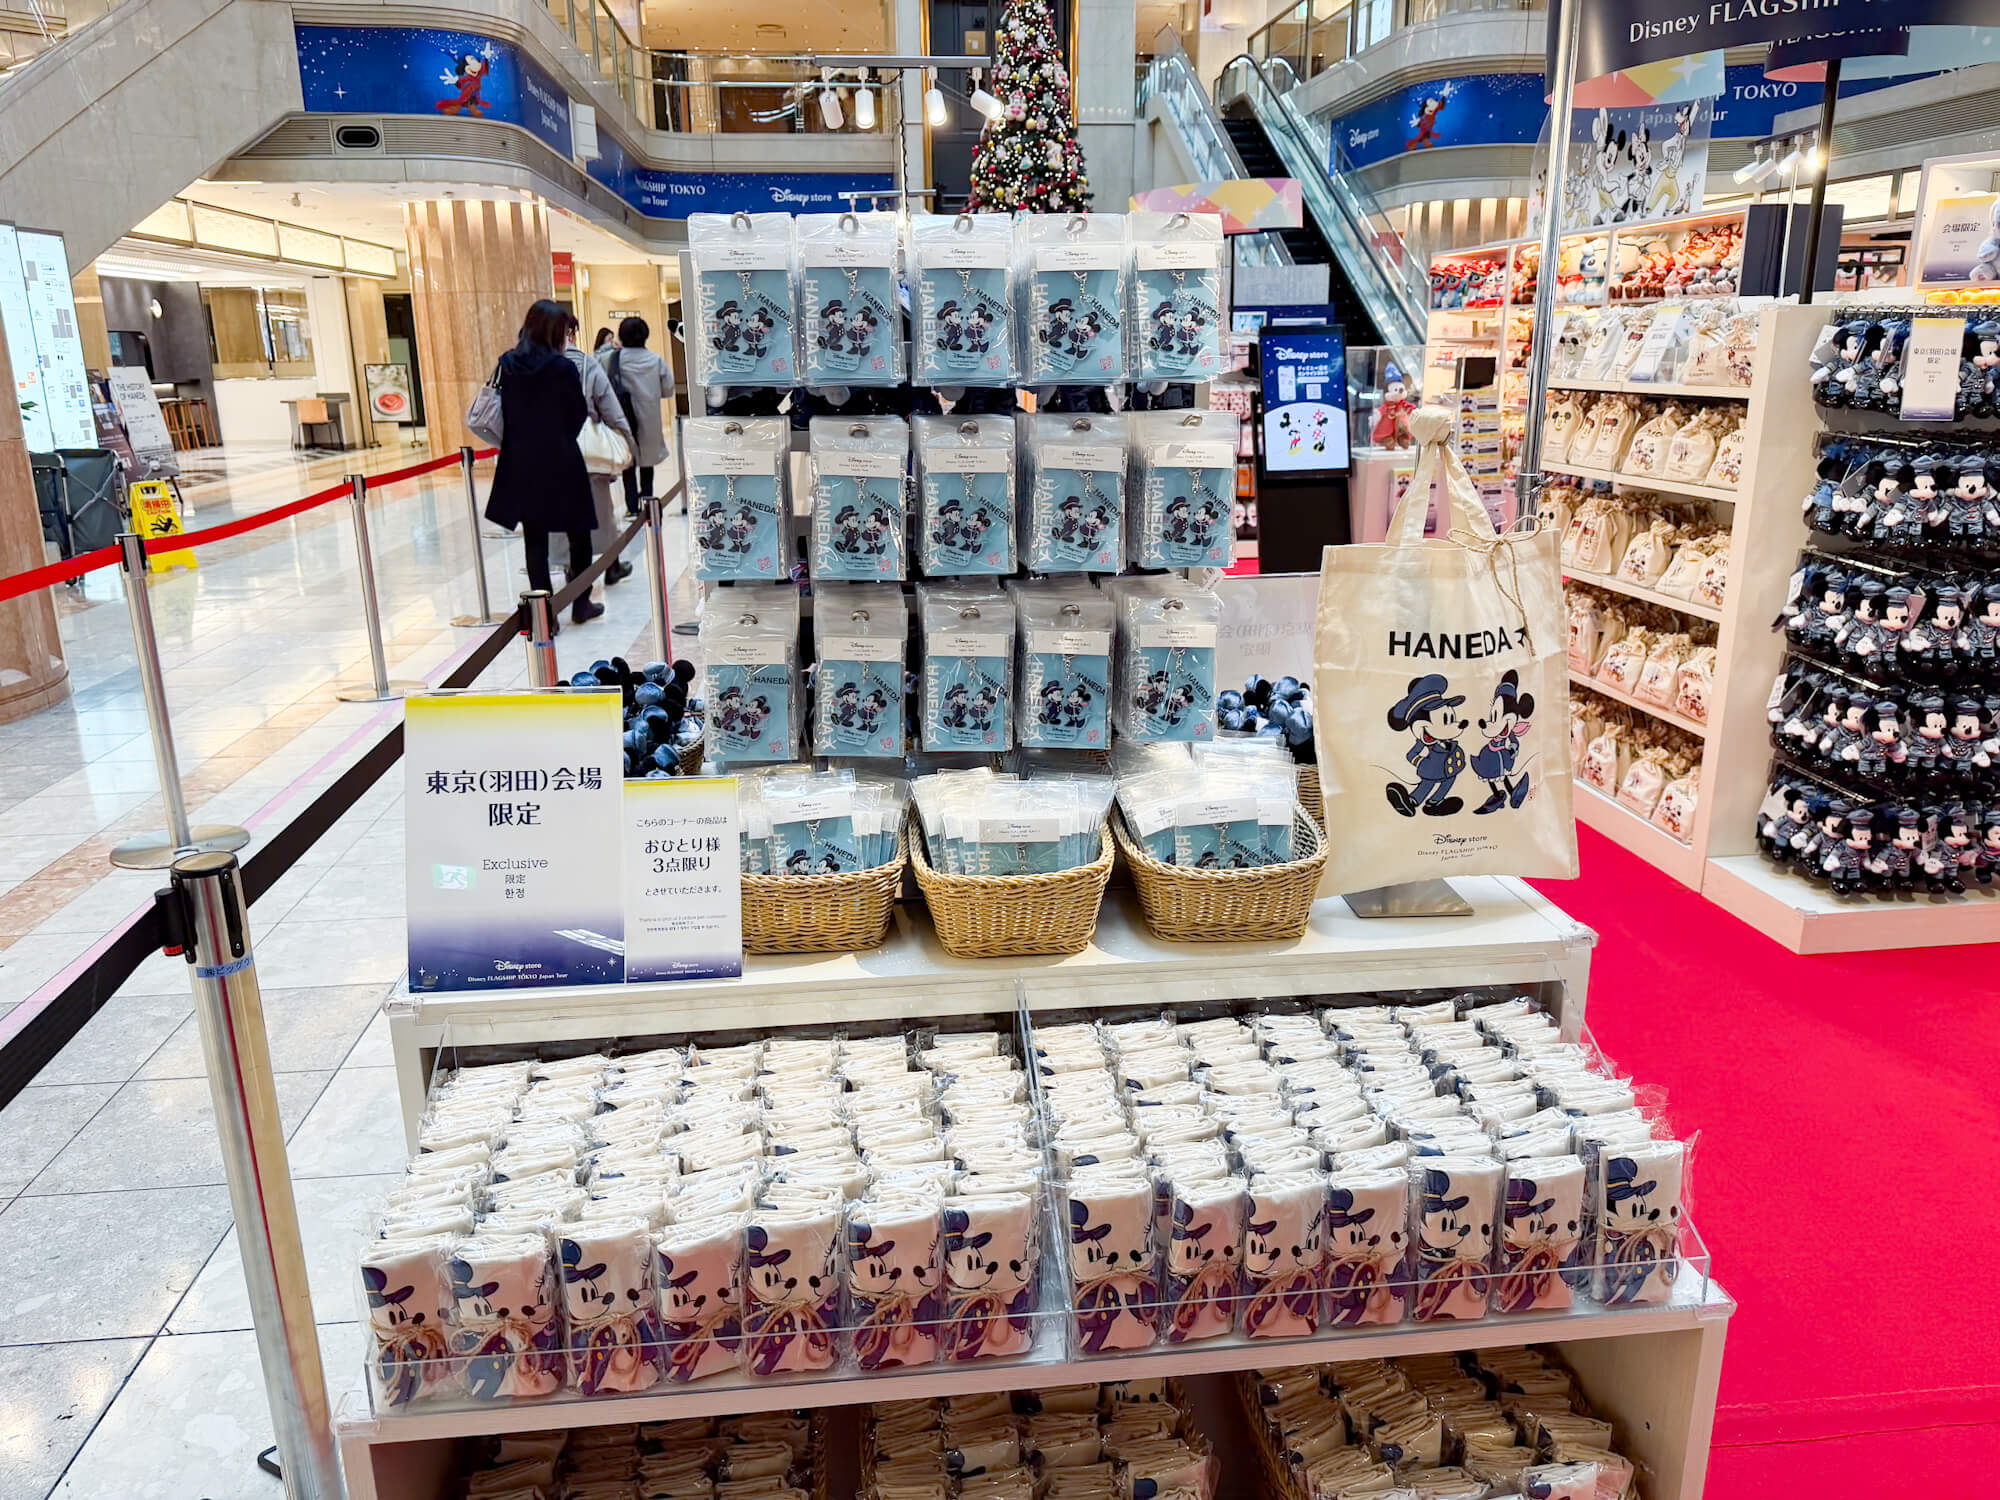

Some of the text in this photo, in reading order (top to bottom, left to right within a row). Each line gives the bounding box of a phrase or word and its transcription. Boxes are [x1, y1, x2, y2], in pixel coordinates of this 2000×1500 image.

[1629, 13, 1700, 43] Disney
[1733, 82, 1798, 101] TOKYO
[669, 184, 706, 196] TOKYO
[769, 187, 833, 207] Disney store
[757, 293, 791, 323] HANEDA
[976, 289, 1008, 316] HANEDA
[1090, 298, 1120, 328] HANEDA
[805, 279, 819, 355] HANEDA
[922, 280, 937, 355] HANEDA
[1273, 346, 1309, 363] Disney
[739, 497, 776, 515] HANEDA
[978, 497, 1009, 524] HANEDA
[1094, 489, 1121, 519] HANEDA
[1151, 477, 1165, 546] HANEDA
[1203, 486, 1230, 514] HANEDA
[817, 485, 831, 556] HANEDA
[1040, 478, 1053, 548] HANEDA
[1388, 625, 1513, 660] HANEDA
[754, 675, 790, 685] HANEDA
[1077, 672, 1106, 697] HANEDA
[1186, 672, 1212, 702] HANEDA
[927, 664, 941, 731] HANEDA
[425, 766, 602, 794] 東京(羽田)会場
[488, 802, 542, 826] 限定
[636, 816, 728, 827] こちらのコーナーの商品は
[645, 836, 721, 854] おひとり様
[1432, 833, 1467, 846] Disney
[482, 857, 549, 871] Exclusive
[652, 856, 711, 873] 3点限り
[824, 842, 857, 864] HANEDA
[505, 874, 526, 884] 限定
[645, 885, 722, 896] とさせていただきます。
[504, 887, 525, 899] 한정
[493, 959, 525, 973] Disney
[467, 976, 486, 984] Disney
[486, 974, 517, 982] FLAGSHIP
[517, 973, 538, 981] TOKYO
[539, 973, 554, 981] Japan
